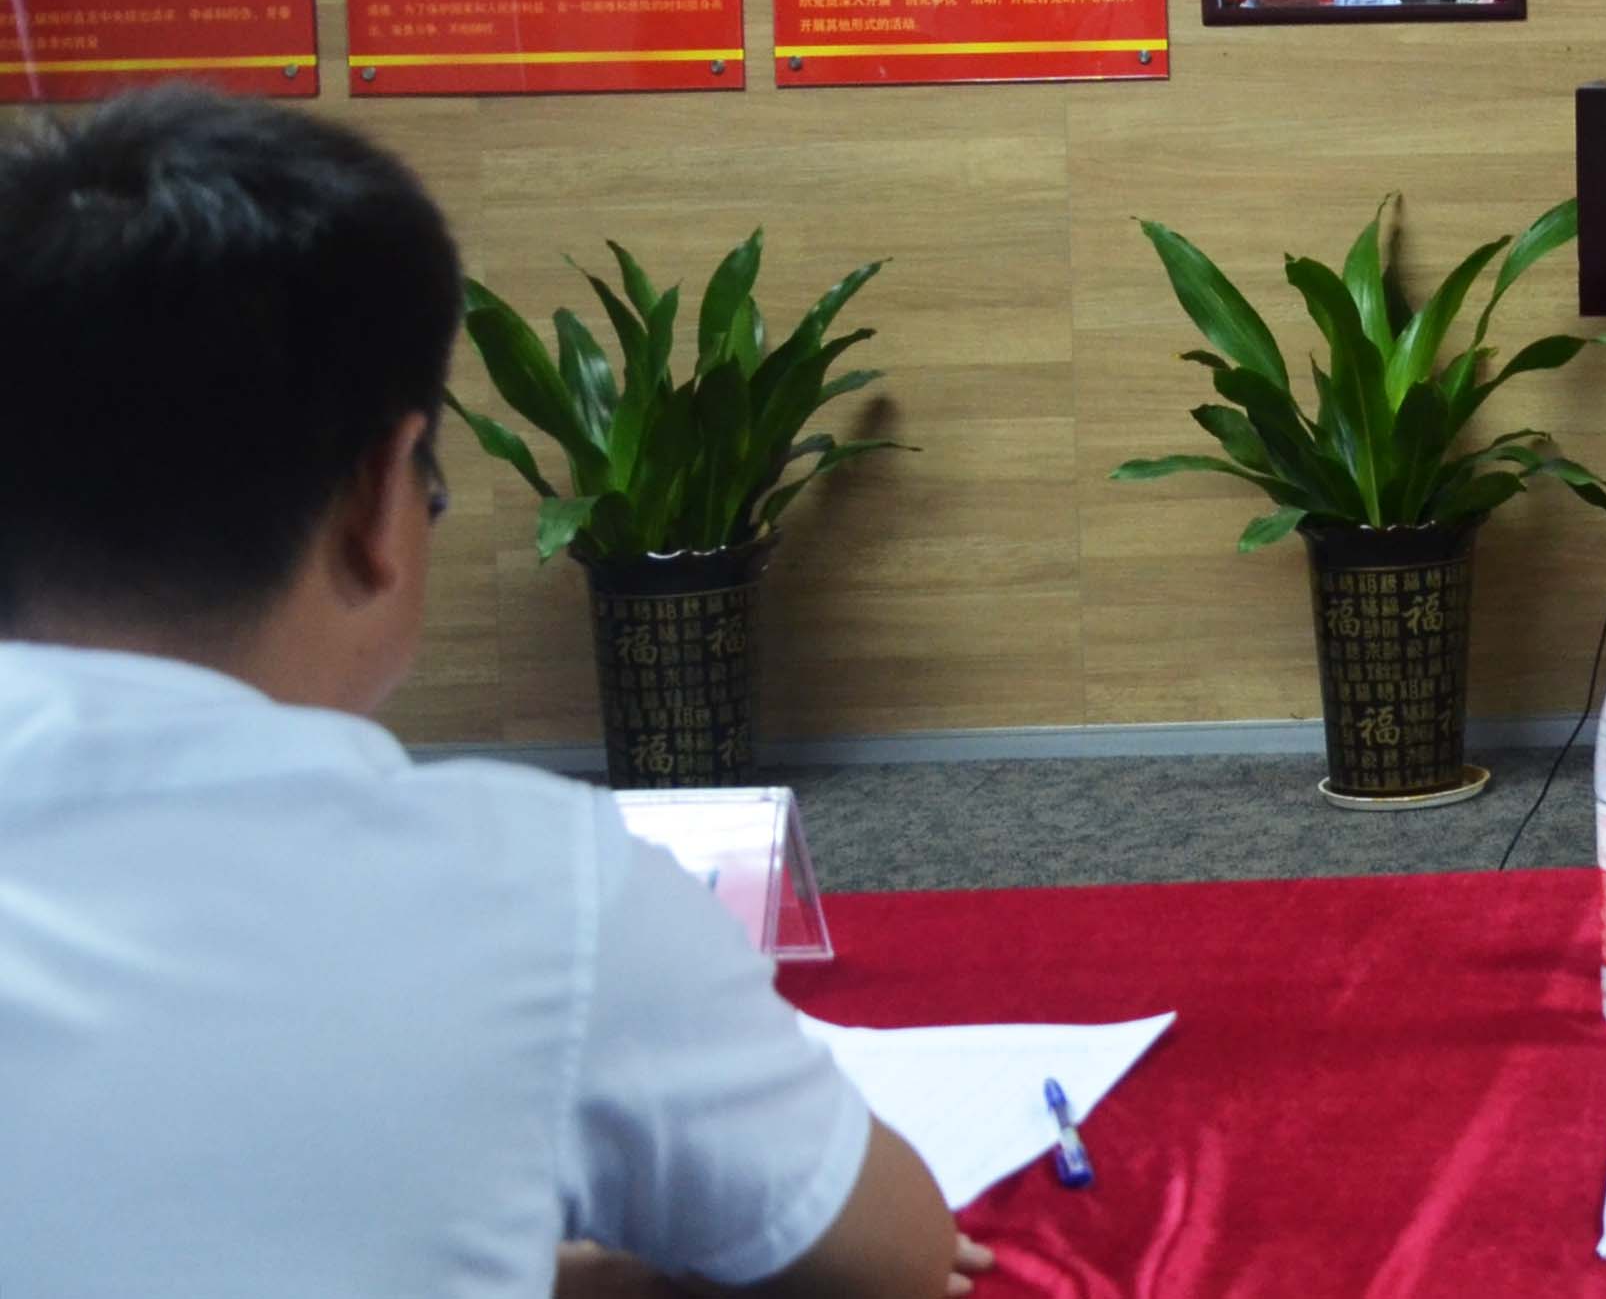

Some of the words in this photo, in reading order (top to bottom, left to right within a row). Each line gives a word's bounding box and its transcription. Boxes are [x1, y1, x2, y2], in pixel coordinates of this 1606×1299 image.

[1327, 600, 1361, 638] 福
[1404, 592, 1444, 634] 福
[616, 624, 657, 665] 福
[1357, 705, 1401, 746] 福
[632, 734, 674, 774] 福
